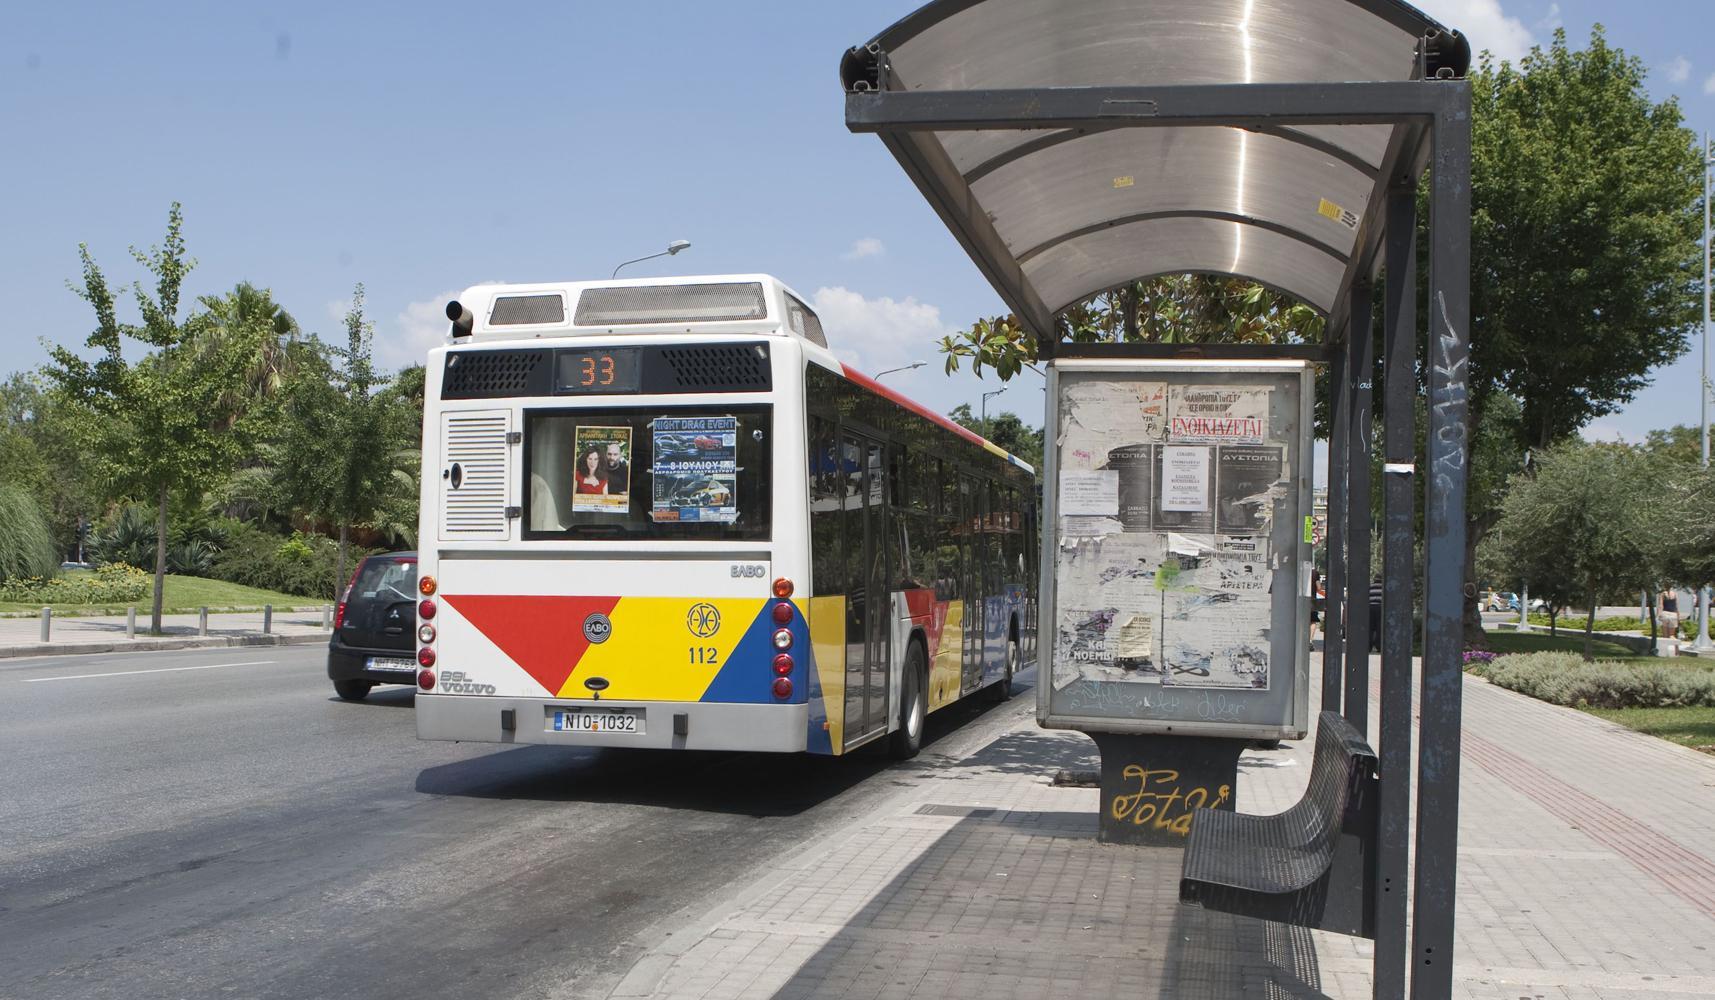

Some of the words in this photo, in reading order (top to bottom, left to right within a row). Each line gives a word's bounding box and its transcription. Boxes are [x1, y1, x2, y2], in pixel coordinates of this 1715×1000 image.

[580, 355, 615, 386] 33
[655, 420, 680, 430] NIGHT
[682, 420, 706, 430] DRAG
[708, 419, 734, 429] EVENT
[1171, 418, 1262, 435] ΕΝΟΙΚΙΑΖΕΤΑΙ
[655, 462, 662, 471] 7
[730, 564, 766, 578] ΕΛΒΟ
[585, 623, 610, 633] ΕΛΒΟ
[689, 647, 718, 664] 112
[440, 682, 496, 695] VOLVO
